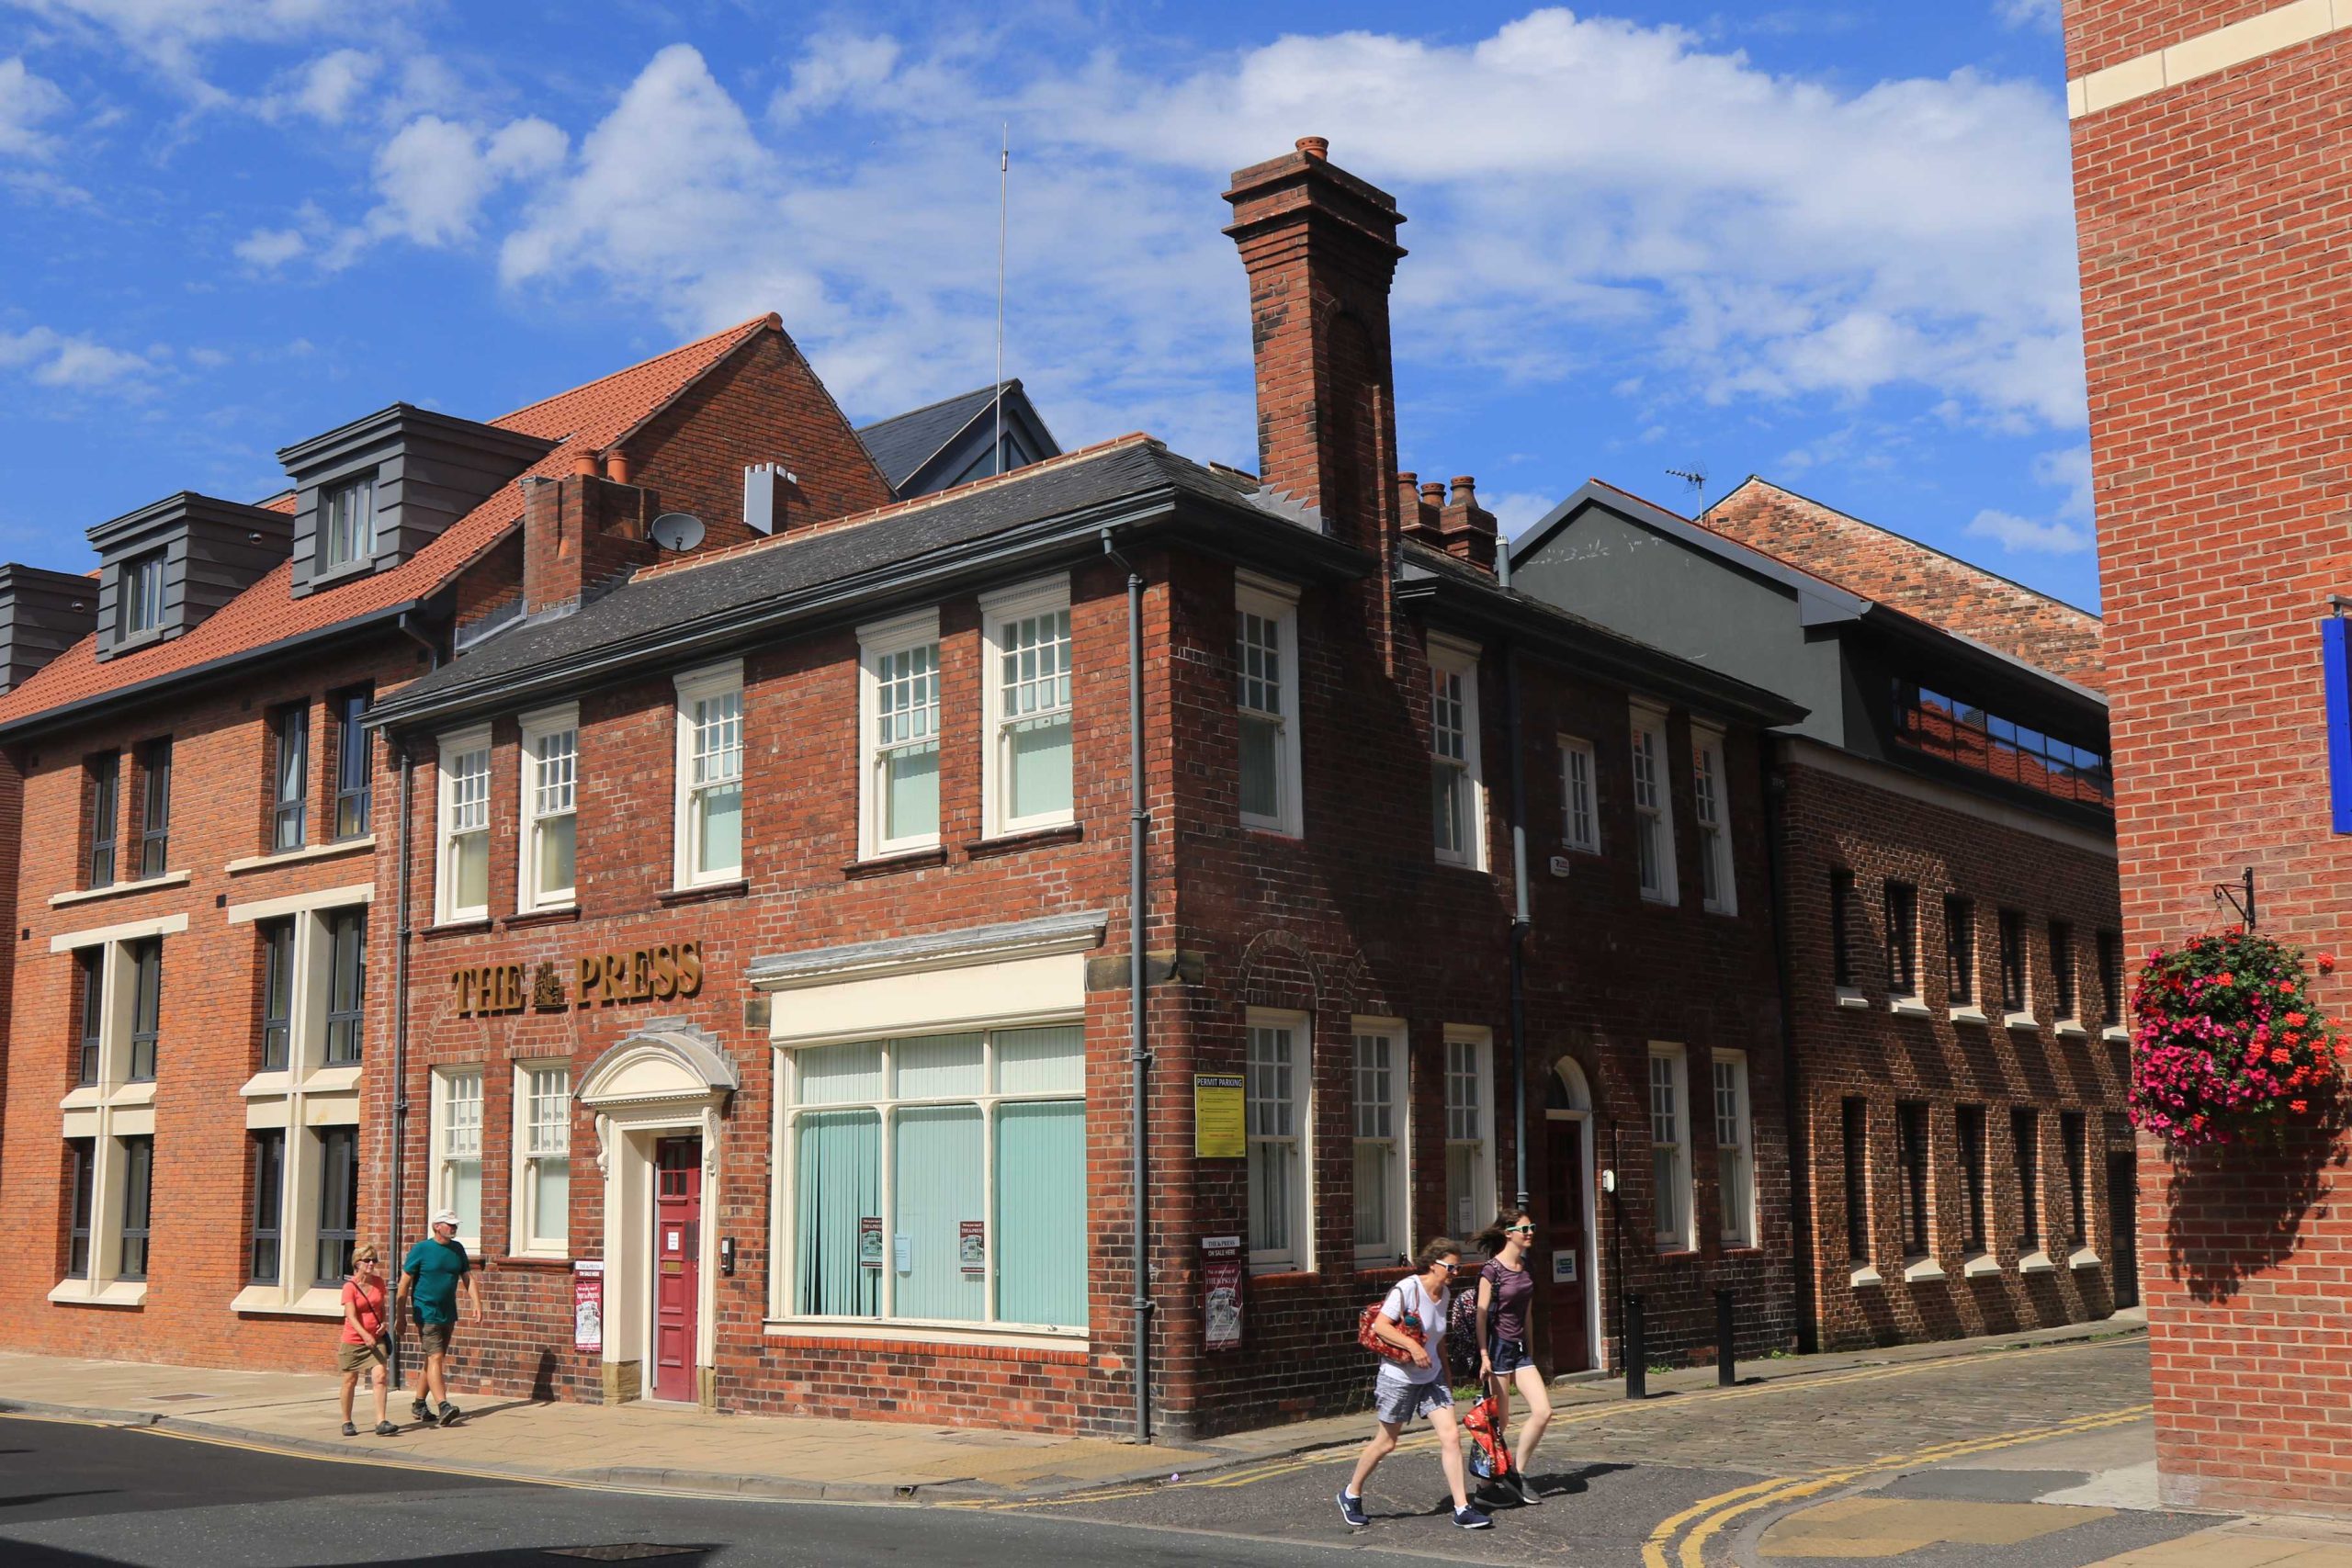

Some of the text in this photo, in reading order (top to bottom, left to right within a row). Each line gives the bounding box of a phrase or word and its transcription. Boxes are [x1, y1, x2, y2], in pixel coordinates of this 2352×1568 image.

[451, 942, 703, 1016] THE PRESS
[1218, 1078, 1242, 1087] PARKING
